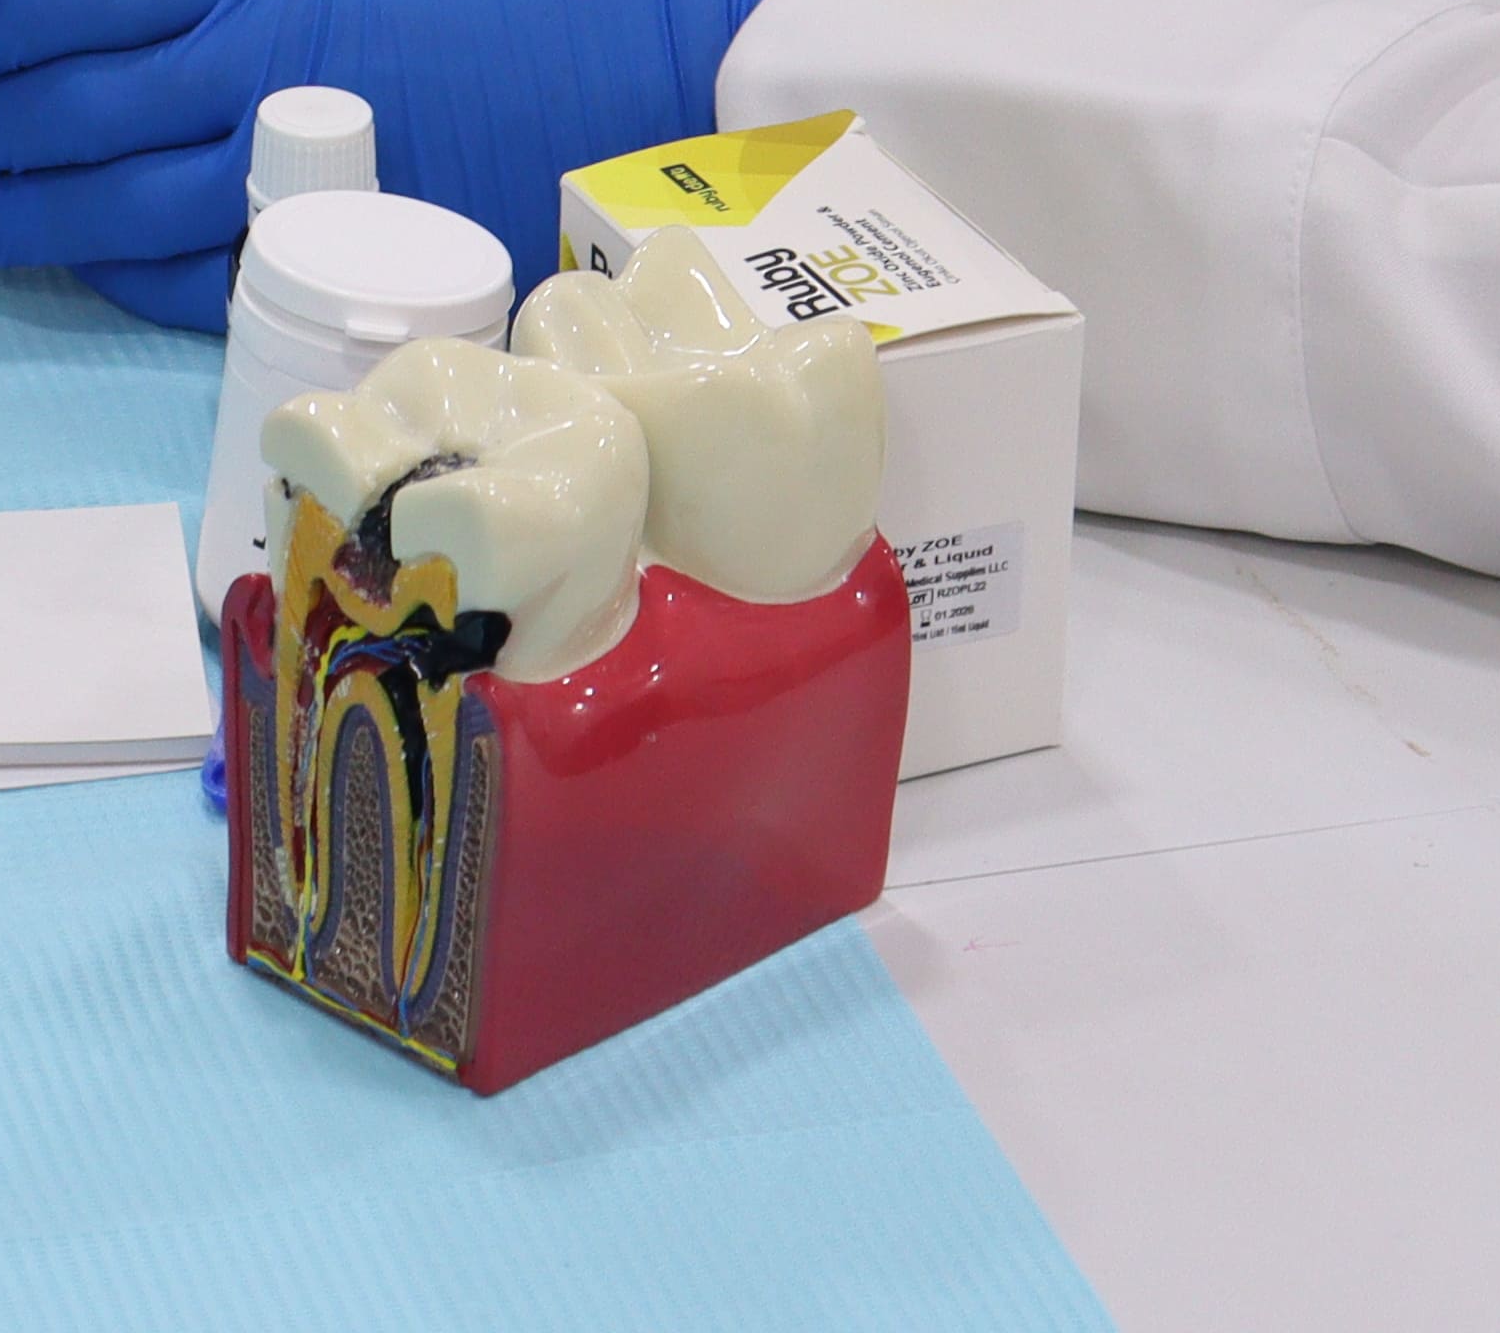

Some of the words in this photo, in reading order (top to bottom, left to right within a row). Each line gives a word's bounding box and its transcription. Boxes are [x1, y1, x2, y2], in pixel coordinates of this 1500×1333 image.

[828, 214, 870, 245] Powder
[855, 218, 898, 251] Cement
[866, 246, 899, 272] Oxide
[892, 252, 942, 288] Eugenol
[744, 247, 839, 322] Ruby
[806, 244, 901, 303] ZOE
[896, 272, 924, 292] Zinc
[893, 546, 916, 558] by
[922, 535, 962, 552] ZOE
[914, 559, 926, 569] &
[934, 545, 993, 565] Liquid
[988, 561, 1009, 574] LLC
